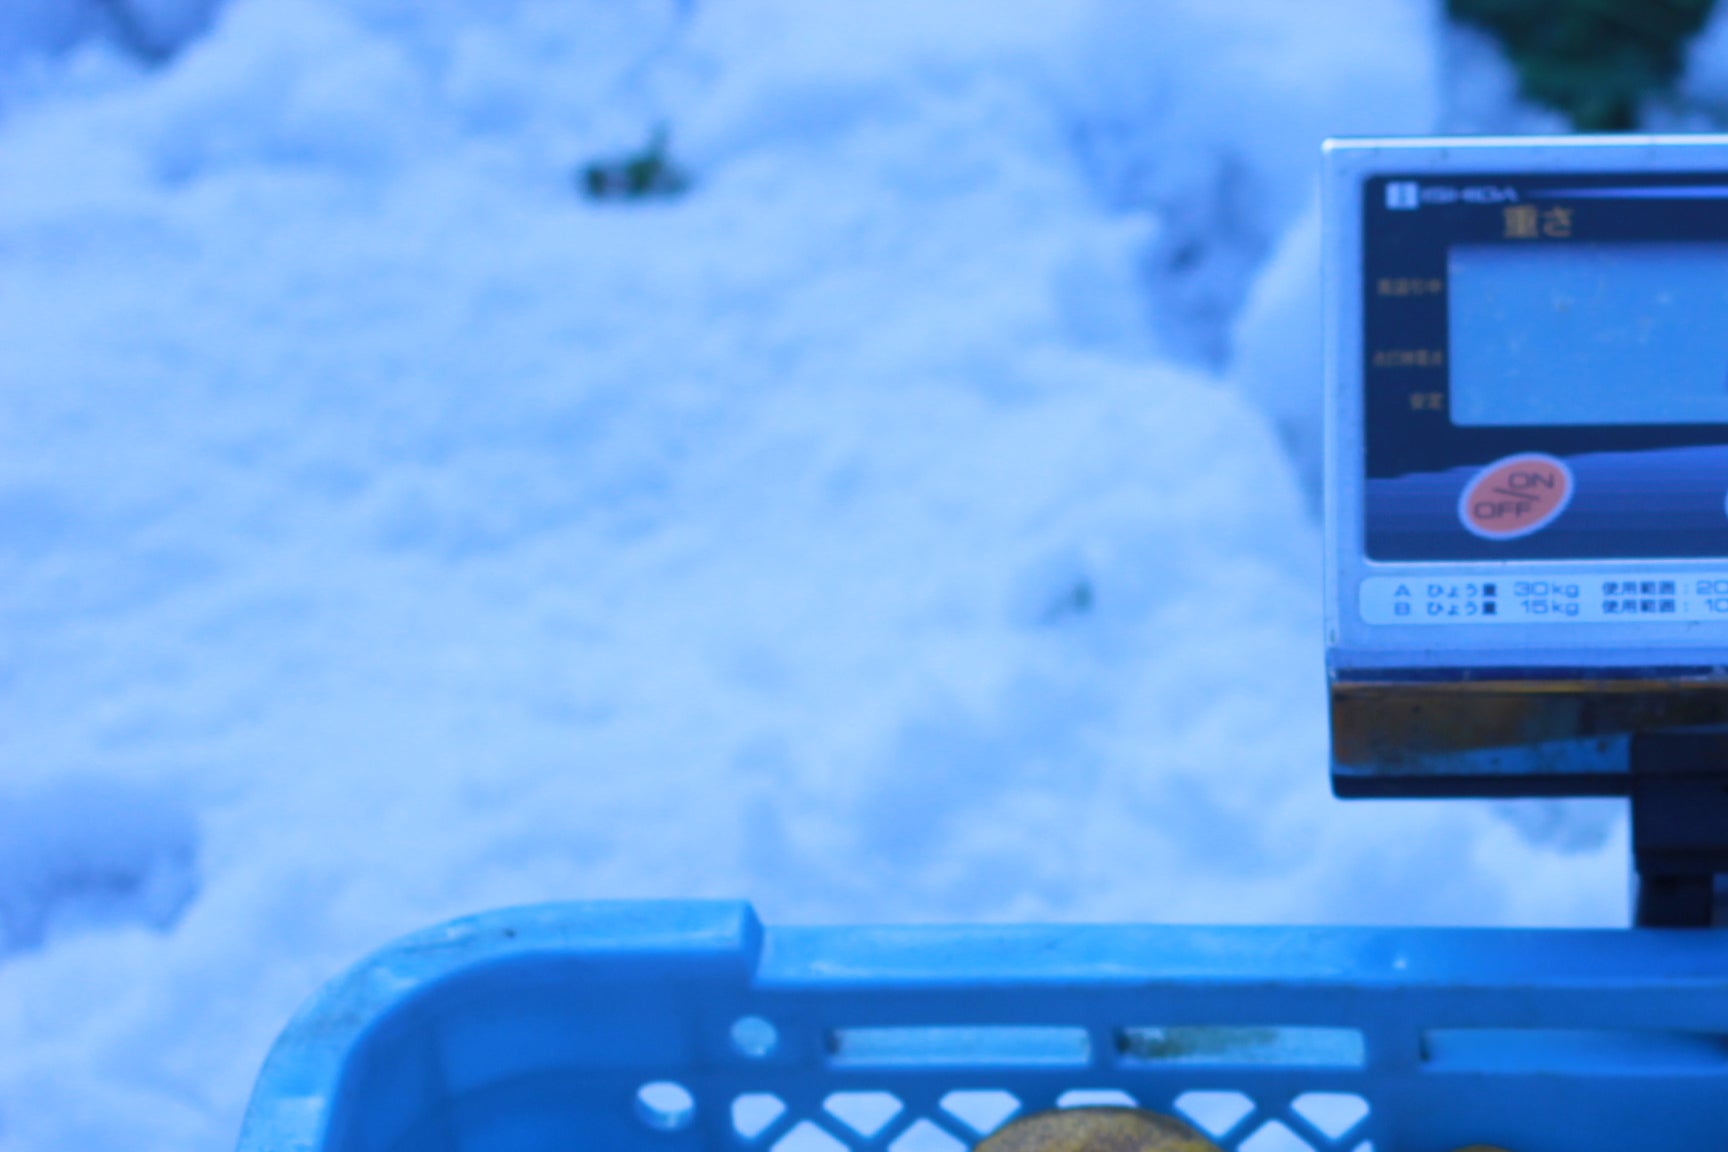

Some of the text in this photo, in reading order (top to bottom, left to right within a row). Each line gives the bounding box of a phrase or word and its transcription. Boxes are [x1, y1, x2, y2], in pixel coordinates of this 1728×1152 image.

[1503, 205, 1573, 238] 重さ
[1508, 472, 1555, 490] ON
[1473, 501, 1532, 519] OFF
[1394, 584, 1412, 598] A
[1514, 581, 1580, 599] 30kg
[1394, 602, 1412, 617] B
[1523, 600, 1580, 617] 15kg
